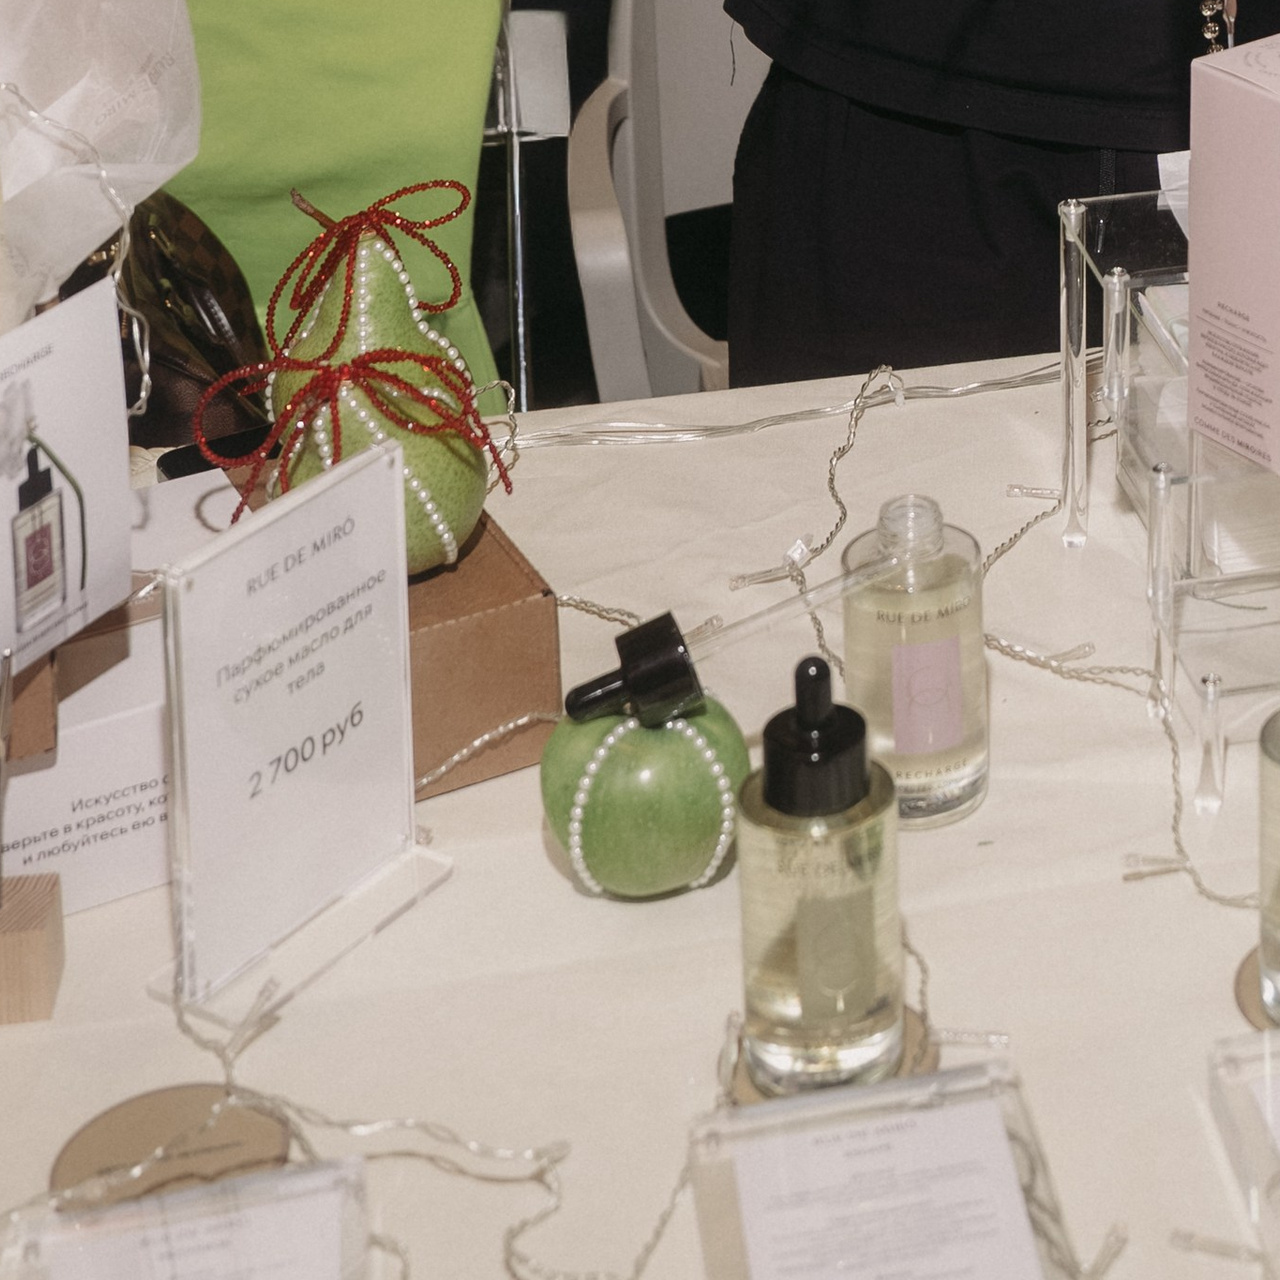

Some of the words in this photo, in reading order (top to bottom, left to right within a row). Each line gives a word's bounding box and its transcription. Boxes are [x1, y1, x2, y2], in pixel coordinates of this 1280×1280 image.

[0, 342, 54, 383] ECHARGE
[1194, 415, 1220, 436] COMME
[1222, 429, 1236, 445] DES
[247, 561, 280, 596] RUE
[284, 545, 306, 574] DE
[216, 568, 386, 688] Парфюмированное
[876, 608, 905, 624] RUE
[911, 608, 933, 624] DE
[234, 661, 285, 704] сухое
[288, 626, 340, 670] масло
[343, 603, 373, 635] для
[287, 661, 326, 694] тела
[250, 770, 263, 800] 2
[269, 736, 315, 785] 700
[322, 700, 364, 756] руб
[896, 758, 968, 781] RECHARGE
[71, 778, 159, 813] Искусство
[63, 824, 73, 834] в
[76, 802, 146, 830] красоту,
[23, 855, 33, 866] и
[37, 827, 128, 862] любуйтесь
[132, 816, 156, 830] ею
